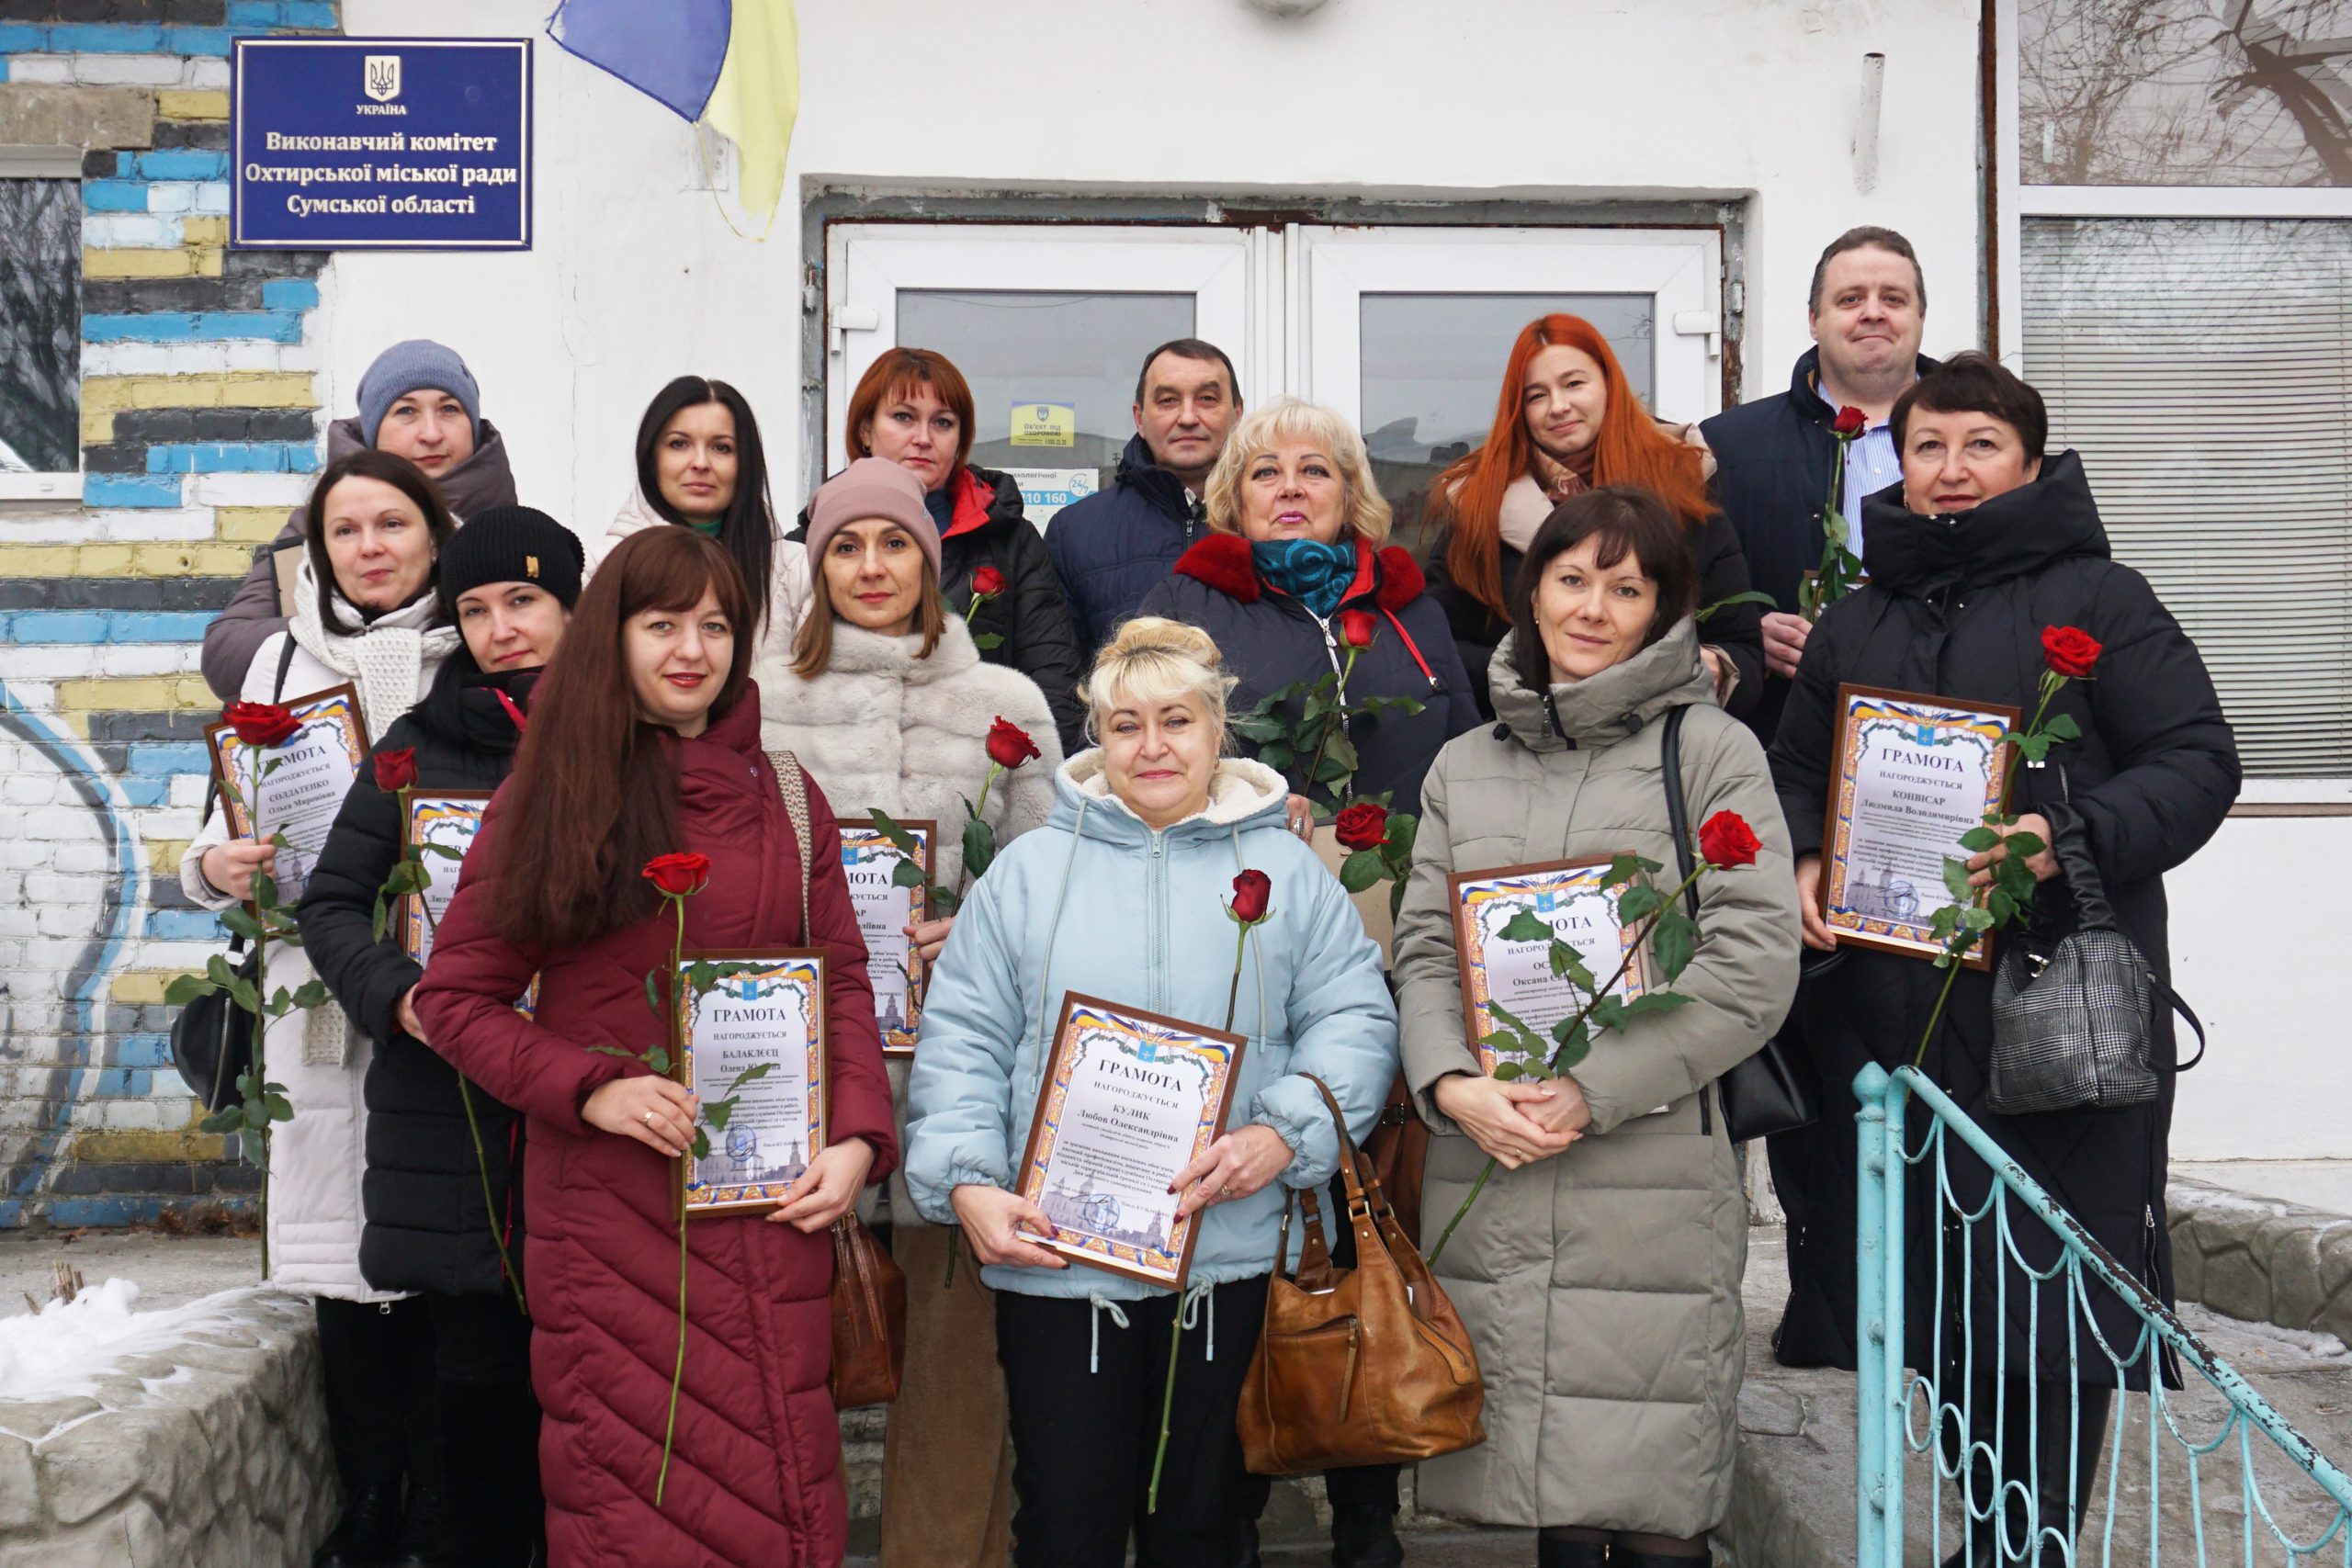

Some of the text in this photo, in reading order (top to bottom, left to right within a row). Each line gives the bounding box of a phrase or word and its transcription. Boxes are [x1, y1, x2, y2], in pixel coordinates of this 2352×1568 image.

[356, 104, 406, 116] УКРАЇНА
[266, 131, 497, 151] Виконавчий комітет
[245, 164, 516, 186] Охтирської міської ради
[287, 195, 475, 218] Сумської області
[1045, 492, 1067, 503] 160
[1882, 749, 1963, 772] ГРАМОТА
[1879, 771, 1962, 789] НАГОРОДЖУЄТЬСЯ
[268, 779, 329, 802] СОЛДАТЕНКО
[1892, 791, 1945, 805] КОНВІСАР
[267, 803, 291, 815] Ольга
[1860, 799, 1903, 812] Людмила
[1905, 807, 1973, 825] Володимирівна
[1532, 960, 1552, 970] ОС
[1512, 975, 1548, 987] Оксана
[713, 1007, 786, 1022] ГРАМОТА
[713, 1031, 786, 1040] НАГОРОДЖУЄТЬСЯ
[722, 1048, 778, 1059] БАЛАКЛЄЄЦ
[720, 1064, 745, 1072] Олена
[1098, 1059, 1182, 1091] ГРАМОТА
[1093, 1081, 1178, 1109] НАГОРОДЖУЄТЬСЯ
[1113, 1104, 1150, 1120] КУЛИК
[1077, 1109, 1108, 1123] Любов
[1109, 1117, 1179, 1143] Олександрівна
